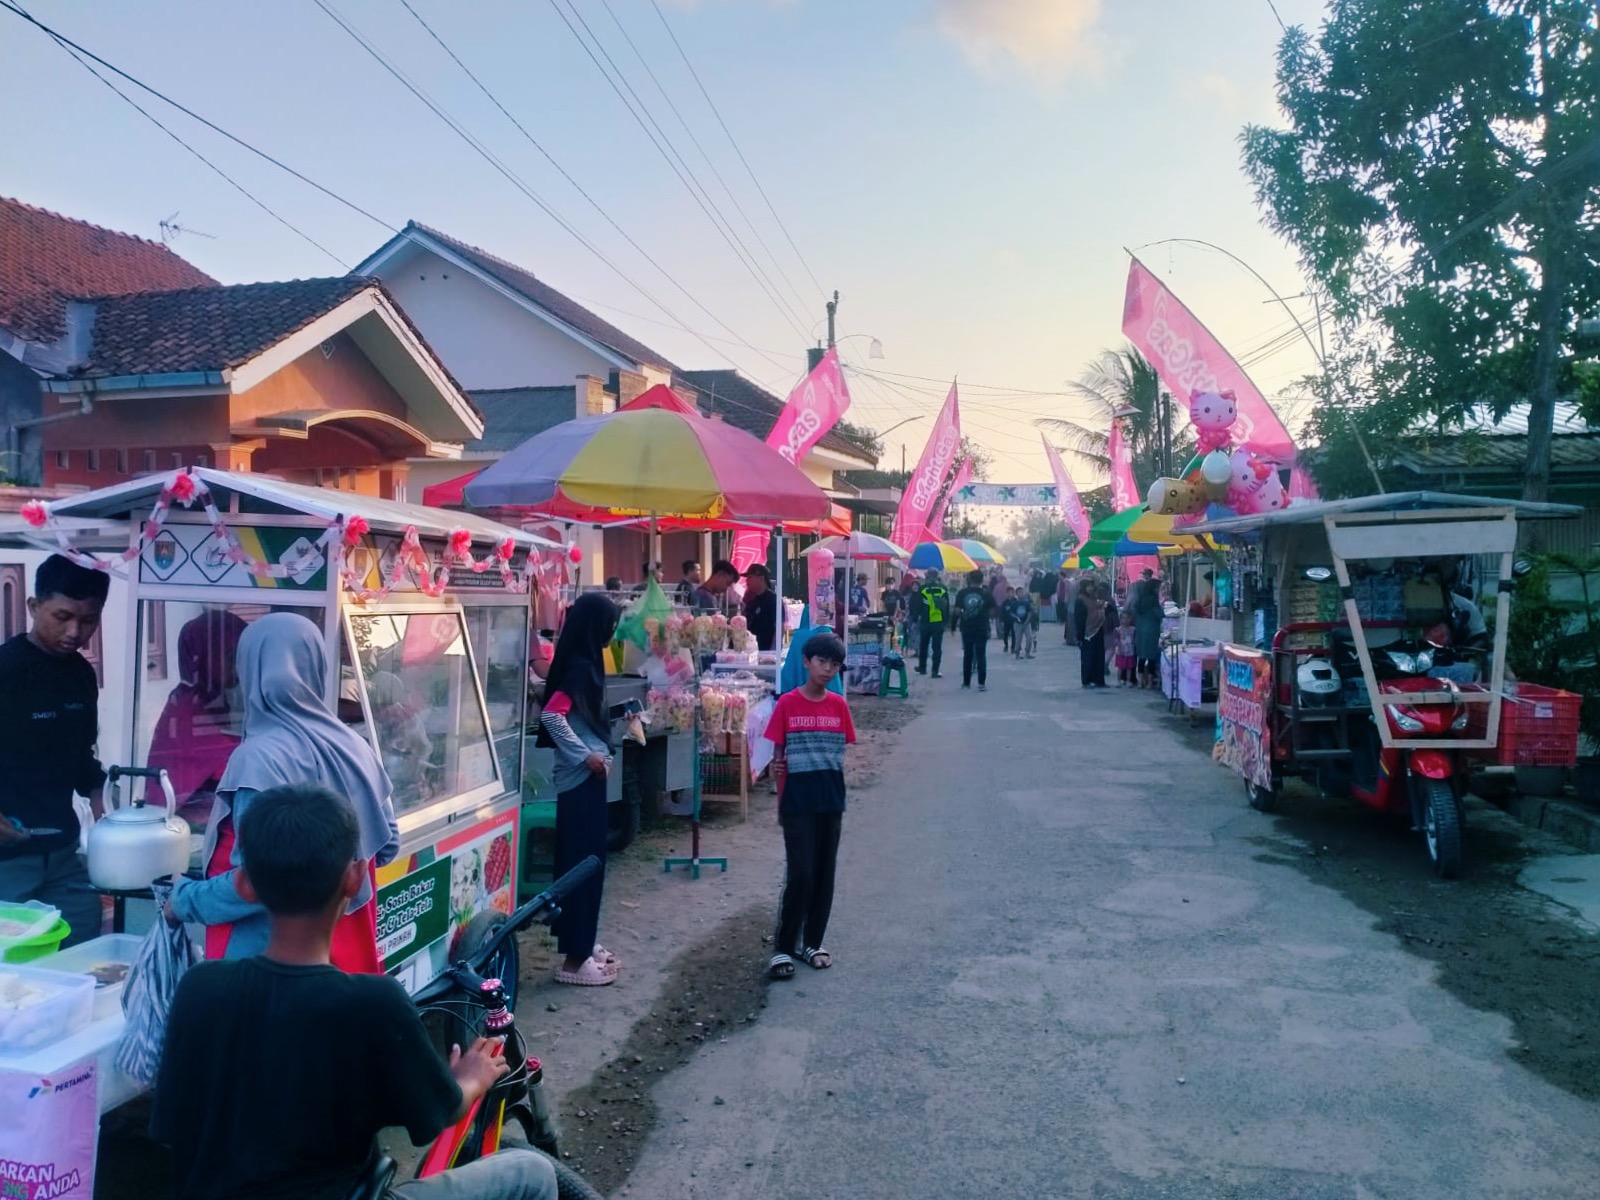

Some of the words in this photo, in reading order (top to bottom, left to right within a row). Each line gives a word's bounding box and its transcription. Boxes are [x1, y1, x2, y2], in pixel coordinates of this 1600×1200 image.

[911, 425, 958, 512] BrightGas
[385, 888, 409, 914] Sosis
[408, 877, 435, 901] Bakar
[33, 1168, 80, 1200] ANDA
